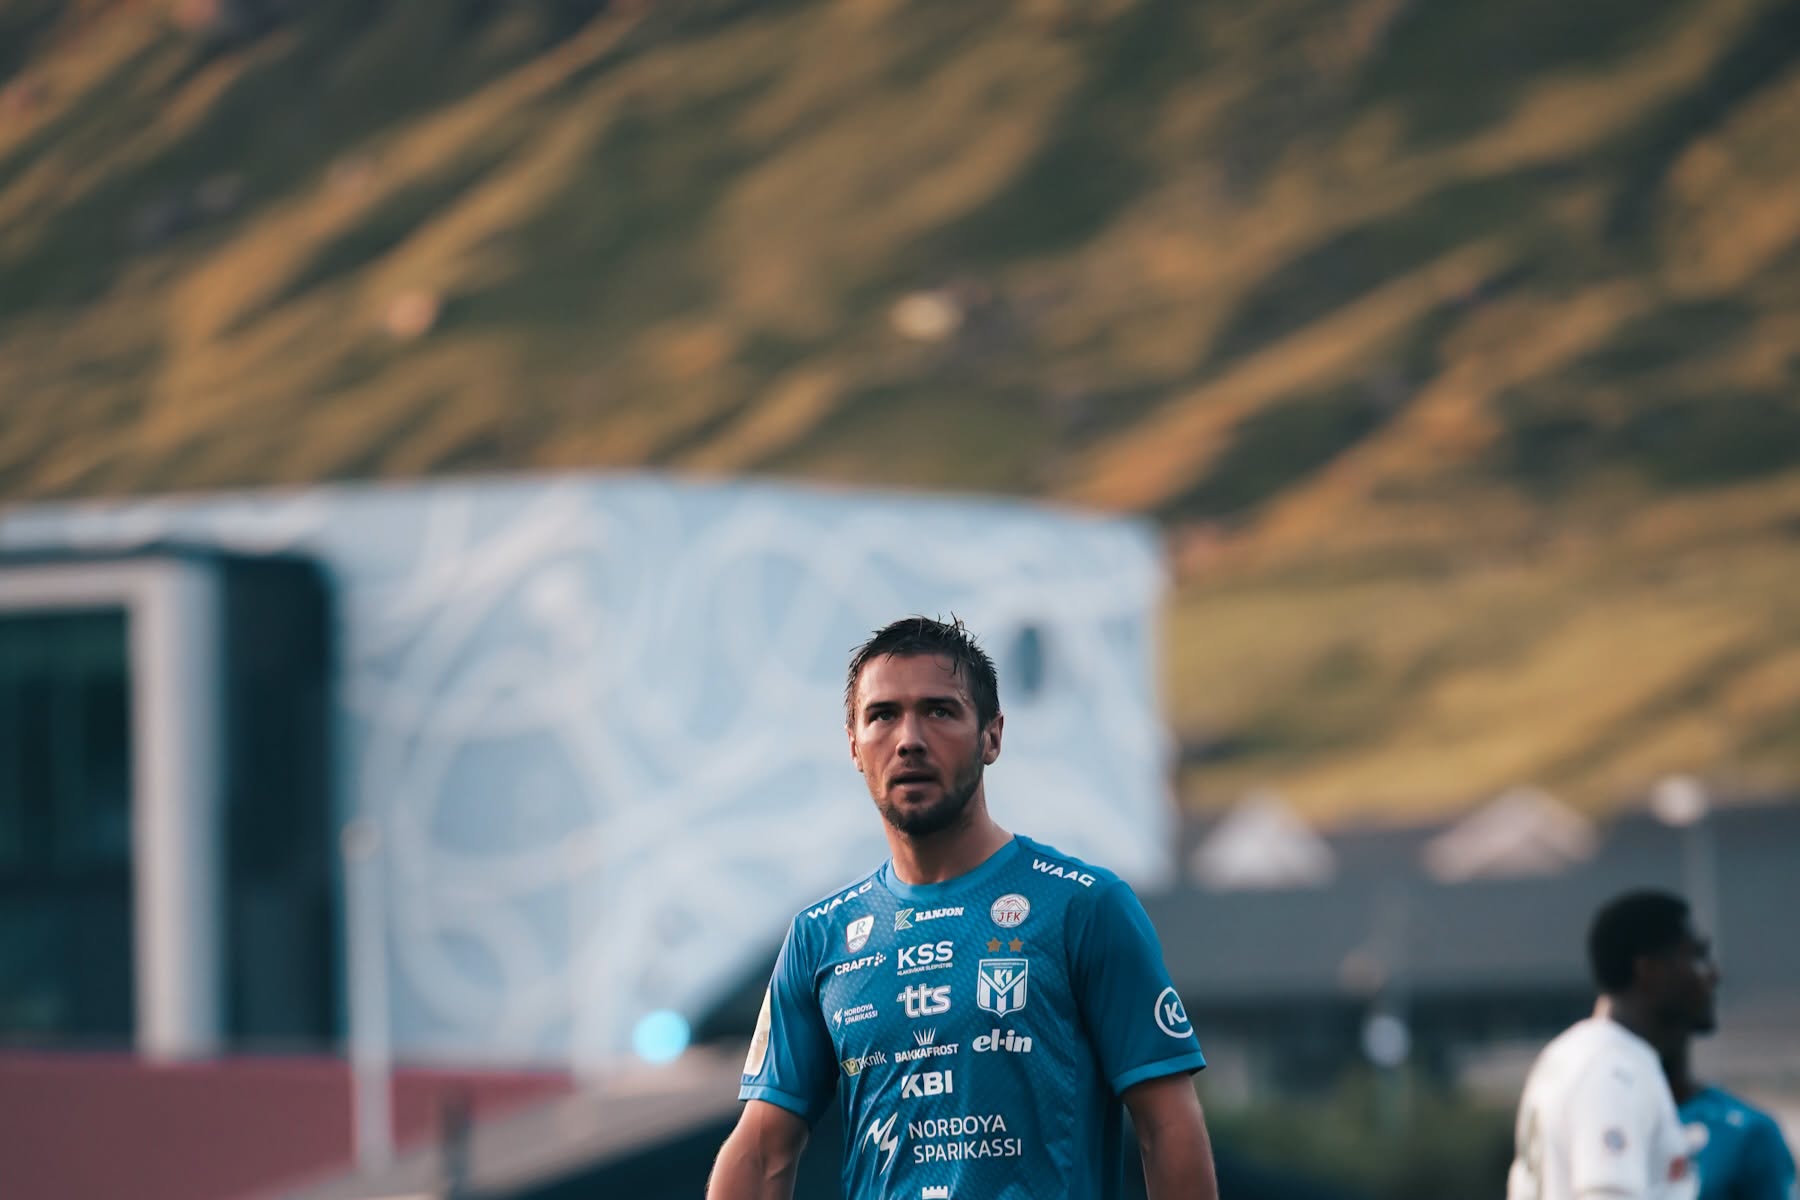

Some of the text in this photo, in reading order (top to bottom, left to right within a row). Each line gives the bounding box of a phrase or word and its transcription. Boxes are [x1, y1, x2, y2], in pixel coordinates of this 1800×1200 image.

[1033, 859, 1096, 887] WAAG
[915, 907, 964, 922] KANJON
[997, 911, 1021, 923] JFK
[835, 956, 874, 976] CRAFT
[897, 940, 954, 970] KSS
[905, 983, 951, 1018] tts
[856, 1051, 888, 1070] Tknik
[895, 1043, 959, 1063] BAKKAFROST
[901, 1070, 953, 1099] KBI
[908, 1114, 1007, 1140] NORÐOYA
[913, 1138, 1022, 1164] SPARIKASSI
